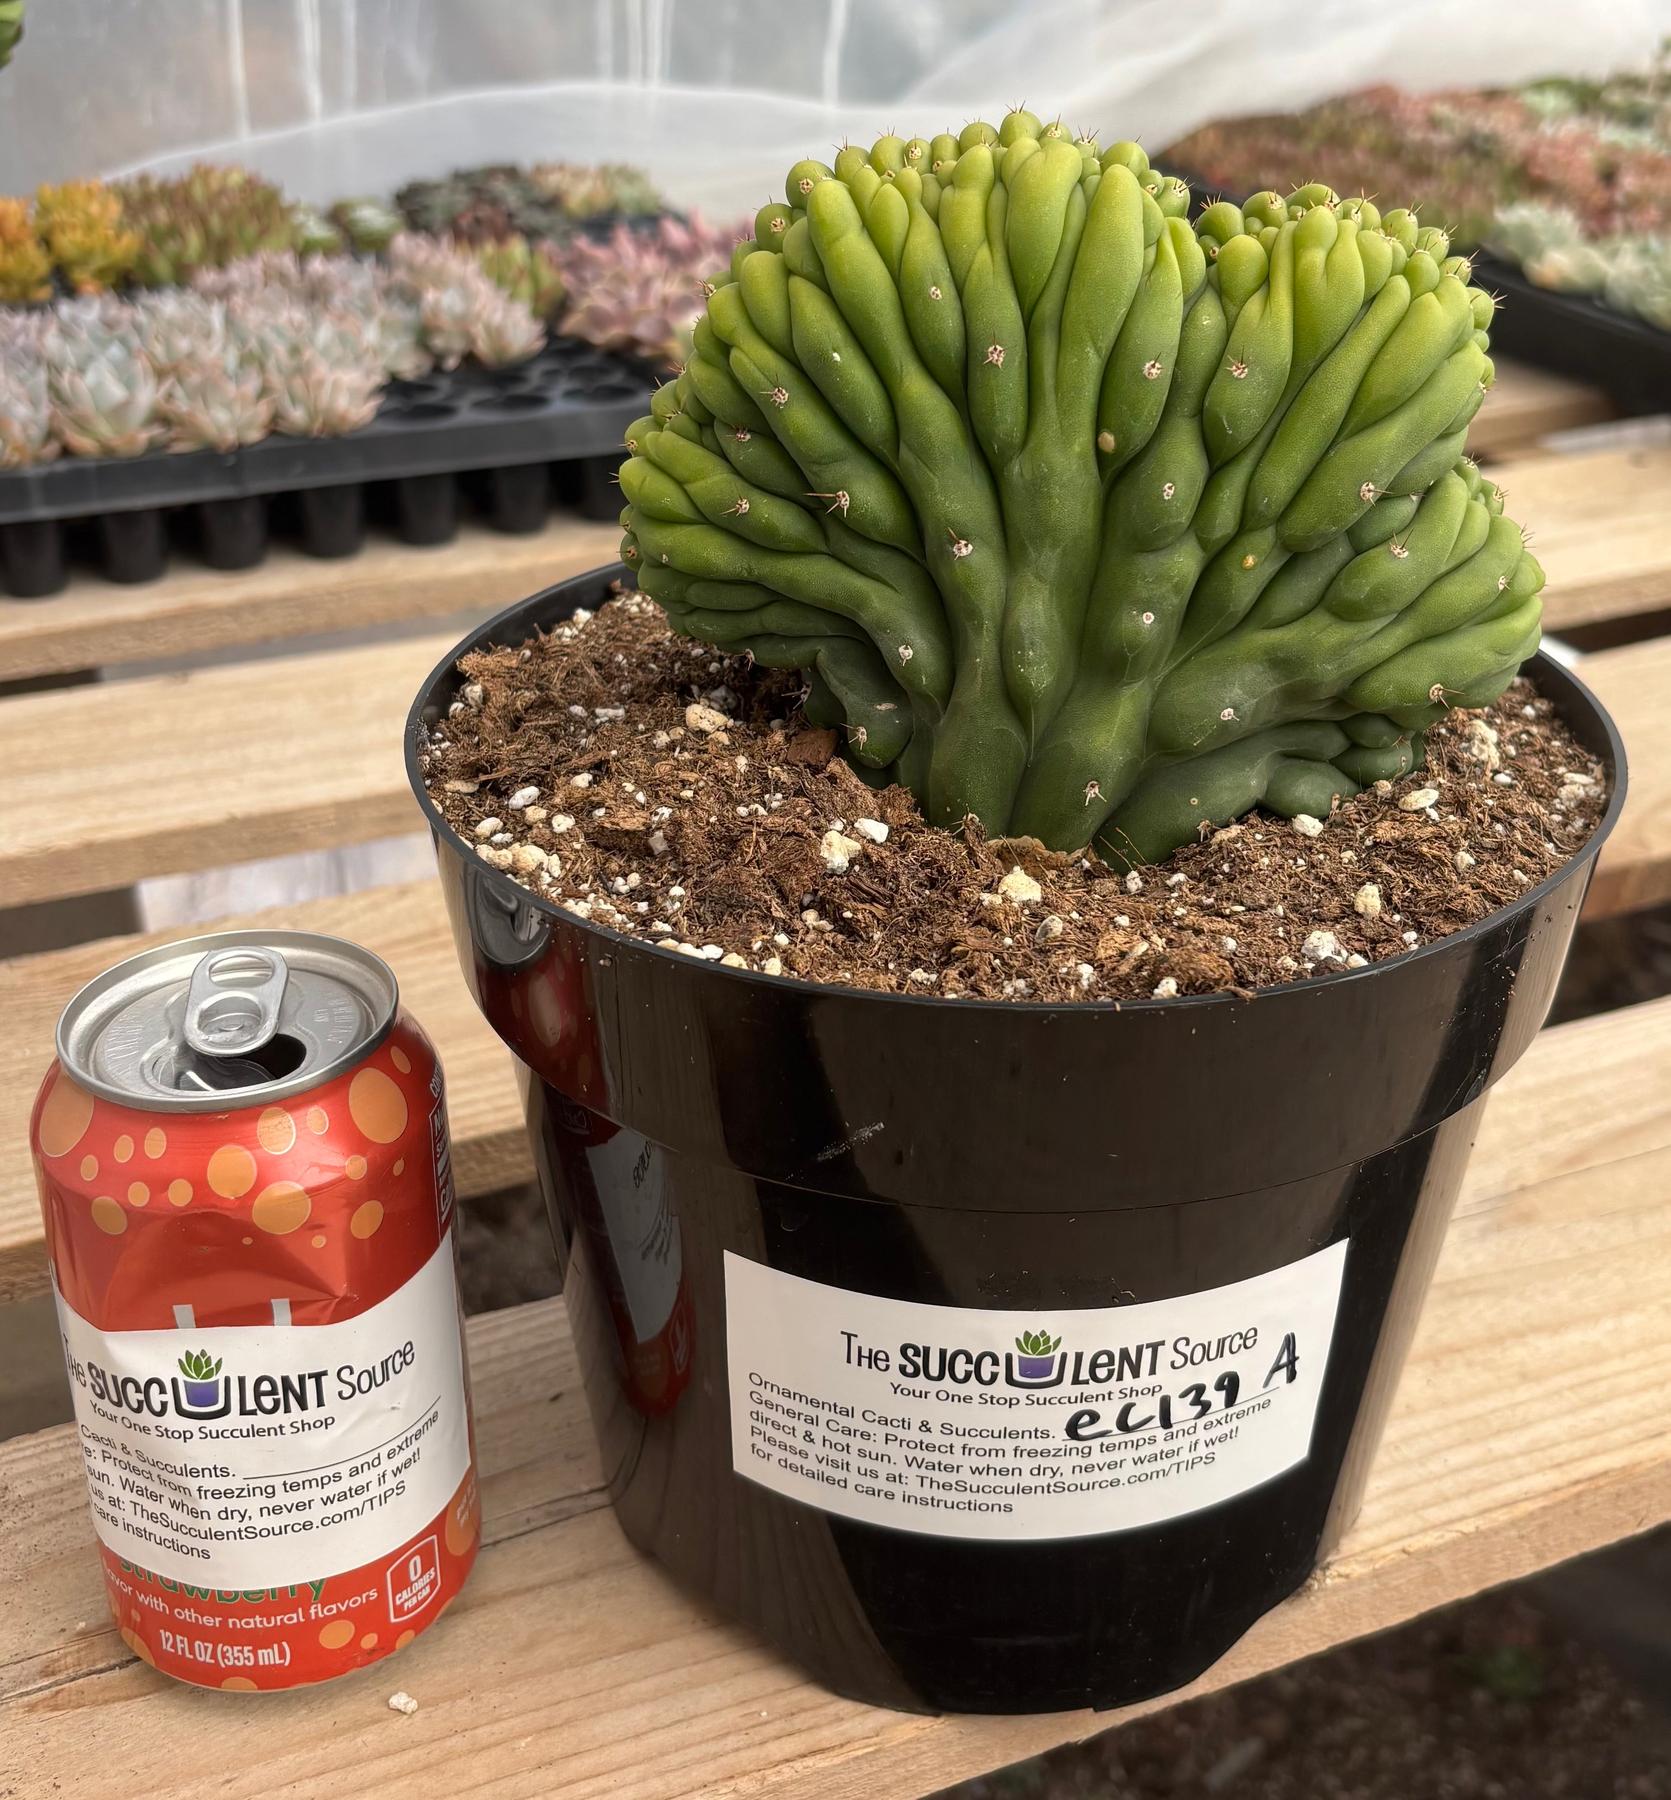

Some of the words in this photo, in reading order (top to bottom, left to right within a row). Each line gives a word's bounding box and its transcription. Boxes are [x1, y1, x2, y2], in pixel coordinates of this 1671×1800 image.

[336, 1340, 415, 1401] Source
[1170, 1326, 1258, 1370] Source
[1262, 1332, 1300, 1388] A
[89, 1399, 118, 1423] Your
[121, 1417, 151, 1436] One
[155, 1424, 194, 1443] Stop
[199, 1423, 285, 1440] Succulent
[290, 1416, 336, 1435] Shop
[749, 1372, 855, 1419] Ornamental
[862, 1409, 911, 1431] Cacti
[918, 1420, 932, 1433] &
[940, 1422, 1056, 1439] Succulents.
[890, 1382, 931, 1400] Your
[936, 1389, 973, 1404] One
[978, 1392, 1020, 1409] Stop
[1025, 1390, 1114, 1406] Succulent
[1118, 1383, 1163, 1399] Shop
[81, 1424, 117, 1450] Cacti
[120, 1443, 132, 1456] &
[135, 1449, 235, 1478] Succulents.
[749, 1390, 819, 1427] General
[826, 1419, 878, 1442] Care:
[885, 1433, 954, 1455] Protect
[961, 1444, 1006, 1458] from
[1013, 1444, 1092, 1459] freezing
[1099, 1433, 1157, 1455] temps
[1163, 1422, 1197, 1442] and
[1203, 1398, 1271, 1431] extreme
[749, 1410, 797, 1438] direct
[802, 1430, 816, 1445] &
[822, 1437, 851, 1454] hot
[857, 1448, 897, 1465] sun.
[904, 1455, 963, 1475] Water
[969, 1462, 1022, 1477] when
[1030, 1465, 1064, 1479] dry,
[1072, 1458, 1126, 1475] never
[1132, 1446, 1184, 1467] water
[1189, 1439, 1202, 1455] if
[1204, 1426, 1240, 1449] wet!
[102, 1449, 154, 1482] Protect
[157, 1474, 192, 1497] from
[196, 1484, 276, 1500] freezing
[282, 1471, 342, 1494] temps
[349, 1453, 381, 1478] and
[387, 1411, 439, 1459] extreme
[750, 1426, 809, 1459] Please
[815, 1452, 851, 1473] visit
[857, 1466, 879, 1480] us
[885, 1471, 909, 1485] at:
[916, 1451, 1216, 1496] TheSucculentSource.com/TIPS
[751, 1444, 773, 1462] for
[778, 1457, 848, 1490] detailed
[854, 1483, 895, 1500] care
[902, 1490, 1014, 1513] instructions
[87, 1464, 114, 1487] sun.
[119, 1475, 164, 1503] Water
[168, 1496, 211, 1520] when
[218, 1506, 252, 1523] dry,
[259, 1498, 315, 1517] never
[320, 1481, 373, 1507] water
[377, 1472, 388, 1487] if
[392, 1447, 421, 1478] wet!
[91, 1483, 104, 1500] us
[108, 1495, 125, 1511] at:
[130, 1480, 406, 1540] TheSucculentSource.com/TIPS
[94, 1503, 118, 1527] care
[123, 1518, 211, 1560] instructions
[136, 1590, 169, 1614] with
[174, 1608, 222, 1627] other
[228, 1608, 305, 1628] natural
[309, 1588, 378, 1620] flavors
[395, 1567, 436, 1605] CALORIES
[403, 1598, 417, 1611] PER
[417, 1585, 431, 1603] CAN
[159, 1629, 175, 1653] 12
[176, 1635, 193, 1659] FL
[195, 1640, 215, 1664] OZ
[217, 1643, 254, 1668] (355
[258, 1641, 291, 1666] mL)
